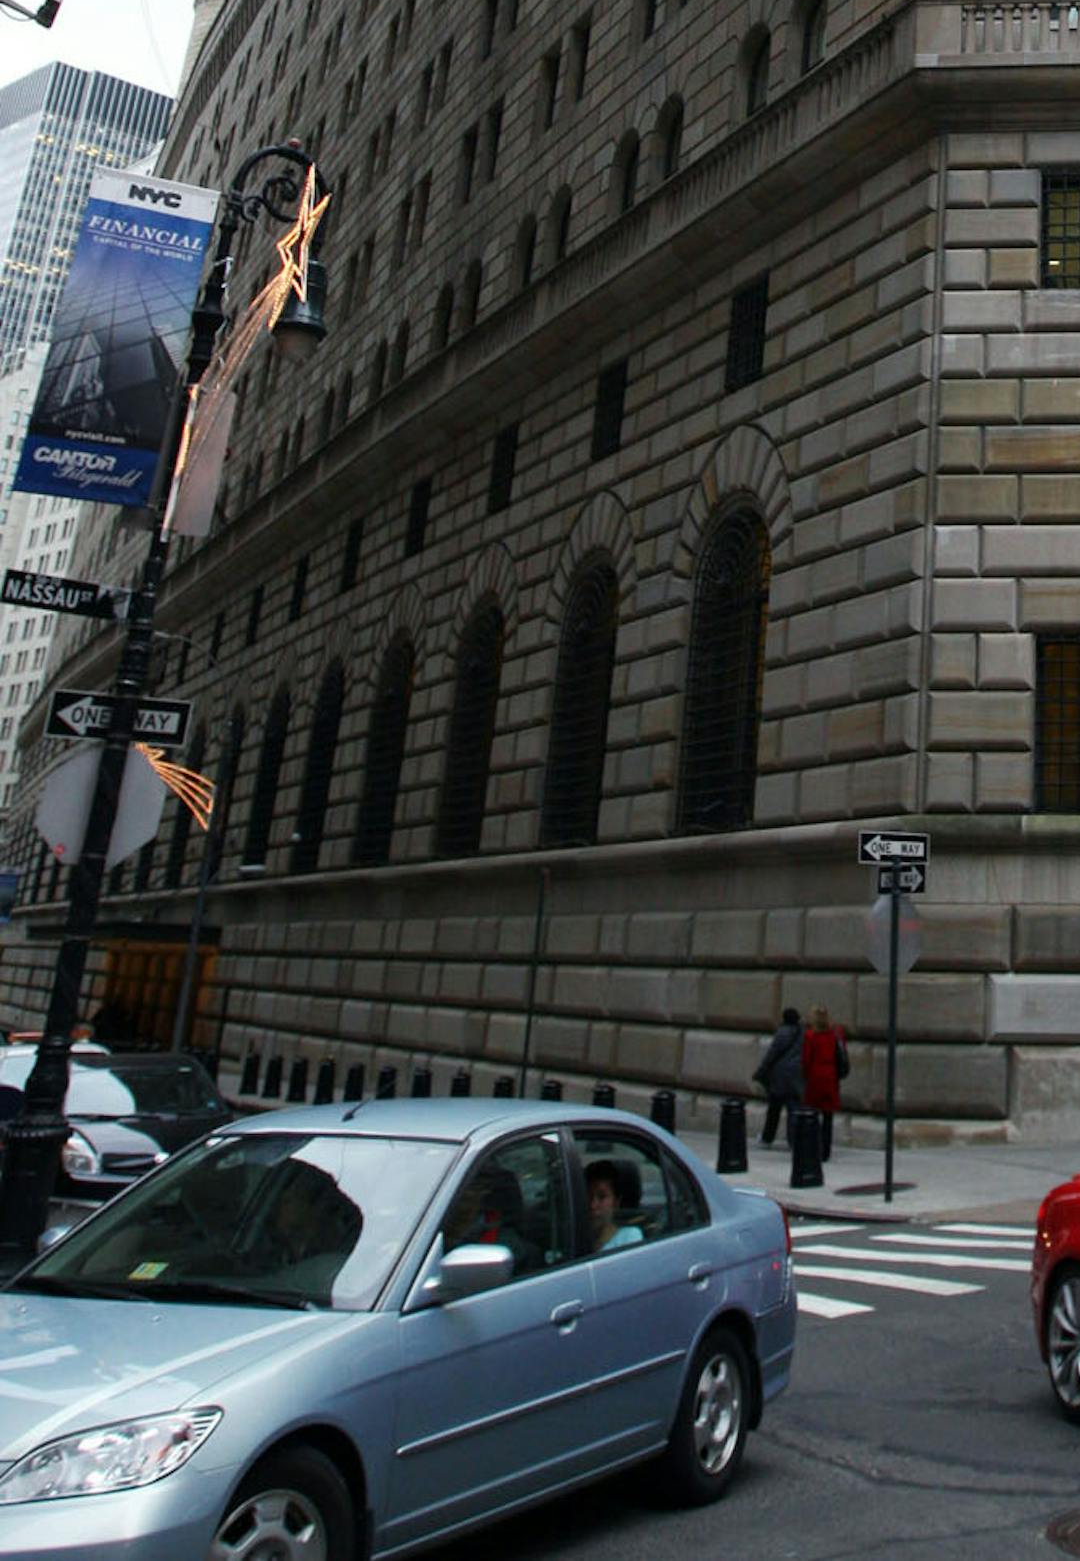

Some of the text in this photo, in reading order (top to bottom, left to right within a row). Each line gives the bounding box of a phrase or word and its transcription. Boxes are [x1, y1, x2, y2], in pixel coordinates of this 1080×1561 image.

[129, 184, 182, 208] NYC
[88, 215, 203, 250] FINANCIAL
[33, 446, 117, 471] CANTOR
[5, 578, 80, 609] NASSAU
[72, 707, 112, 726] ONE
[871, 841, 921, 855] ONE WAY
